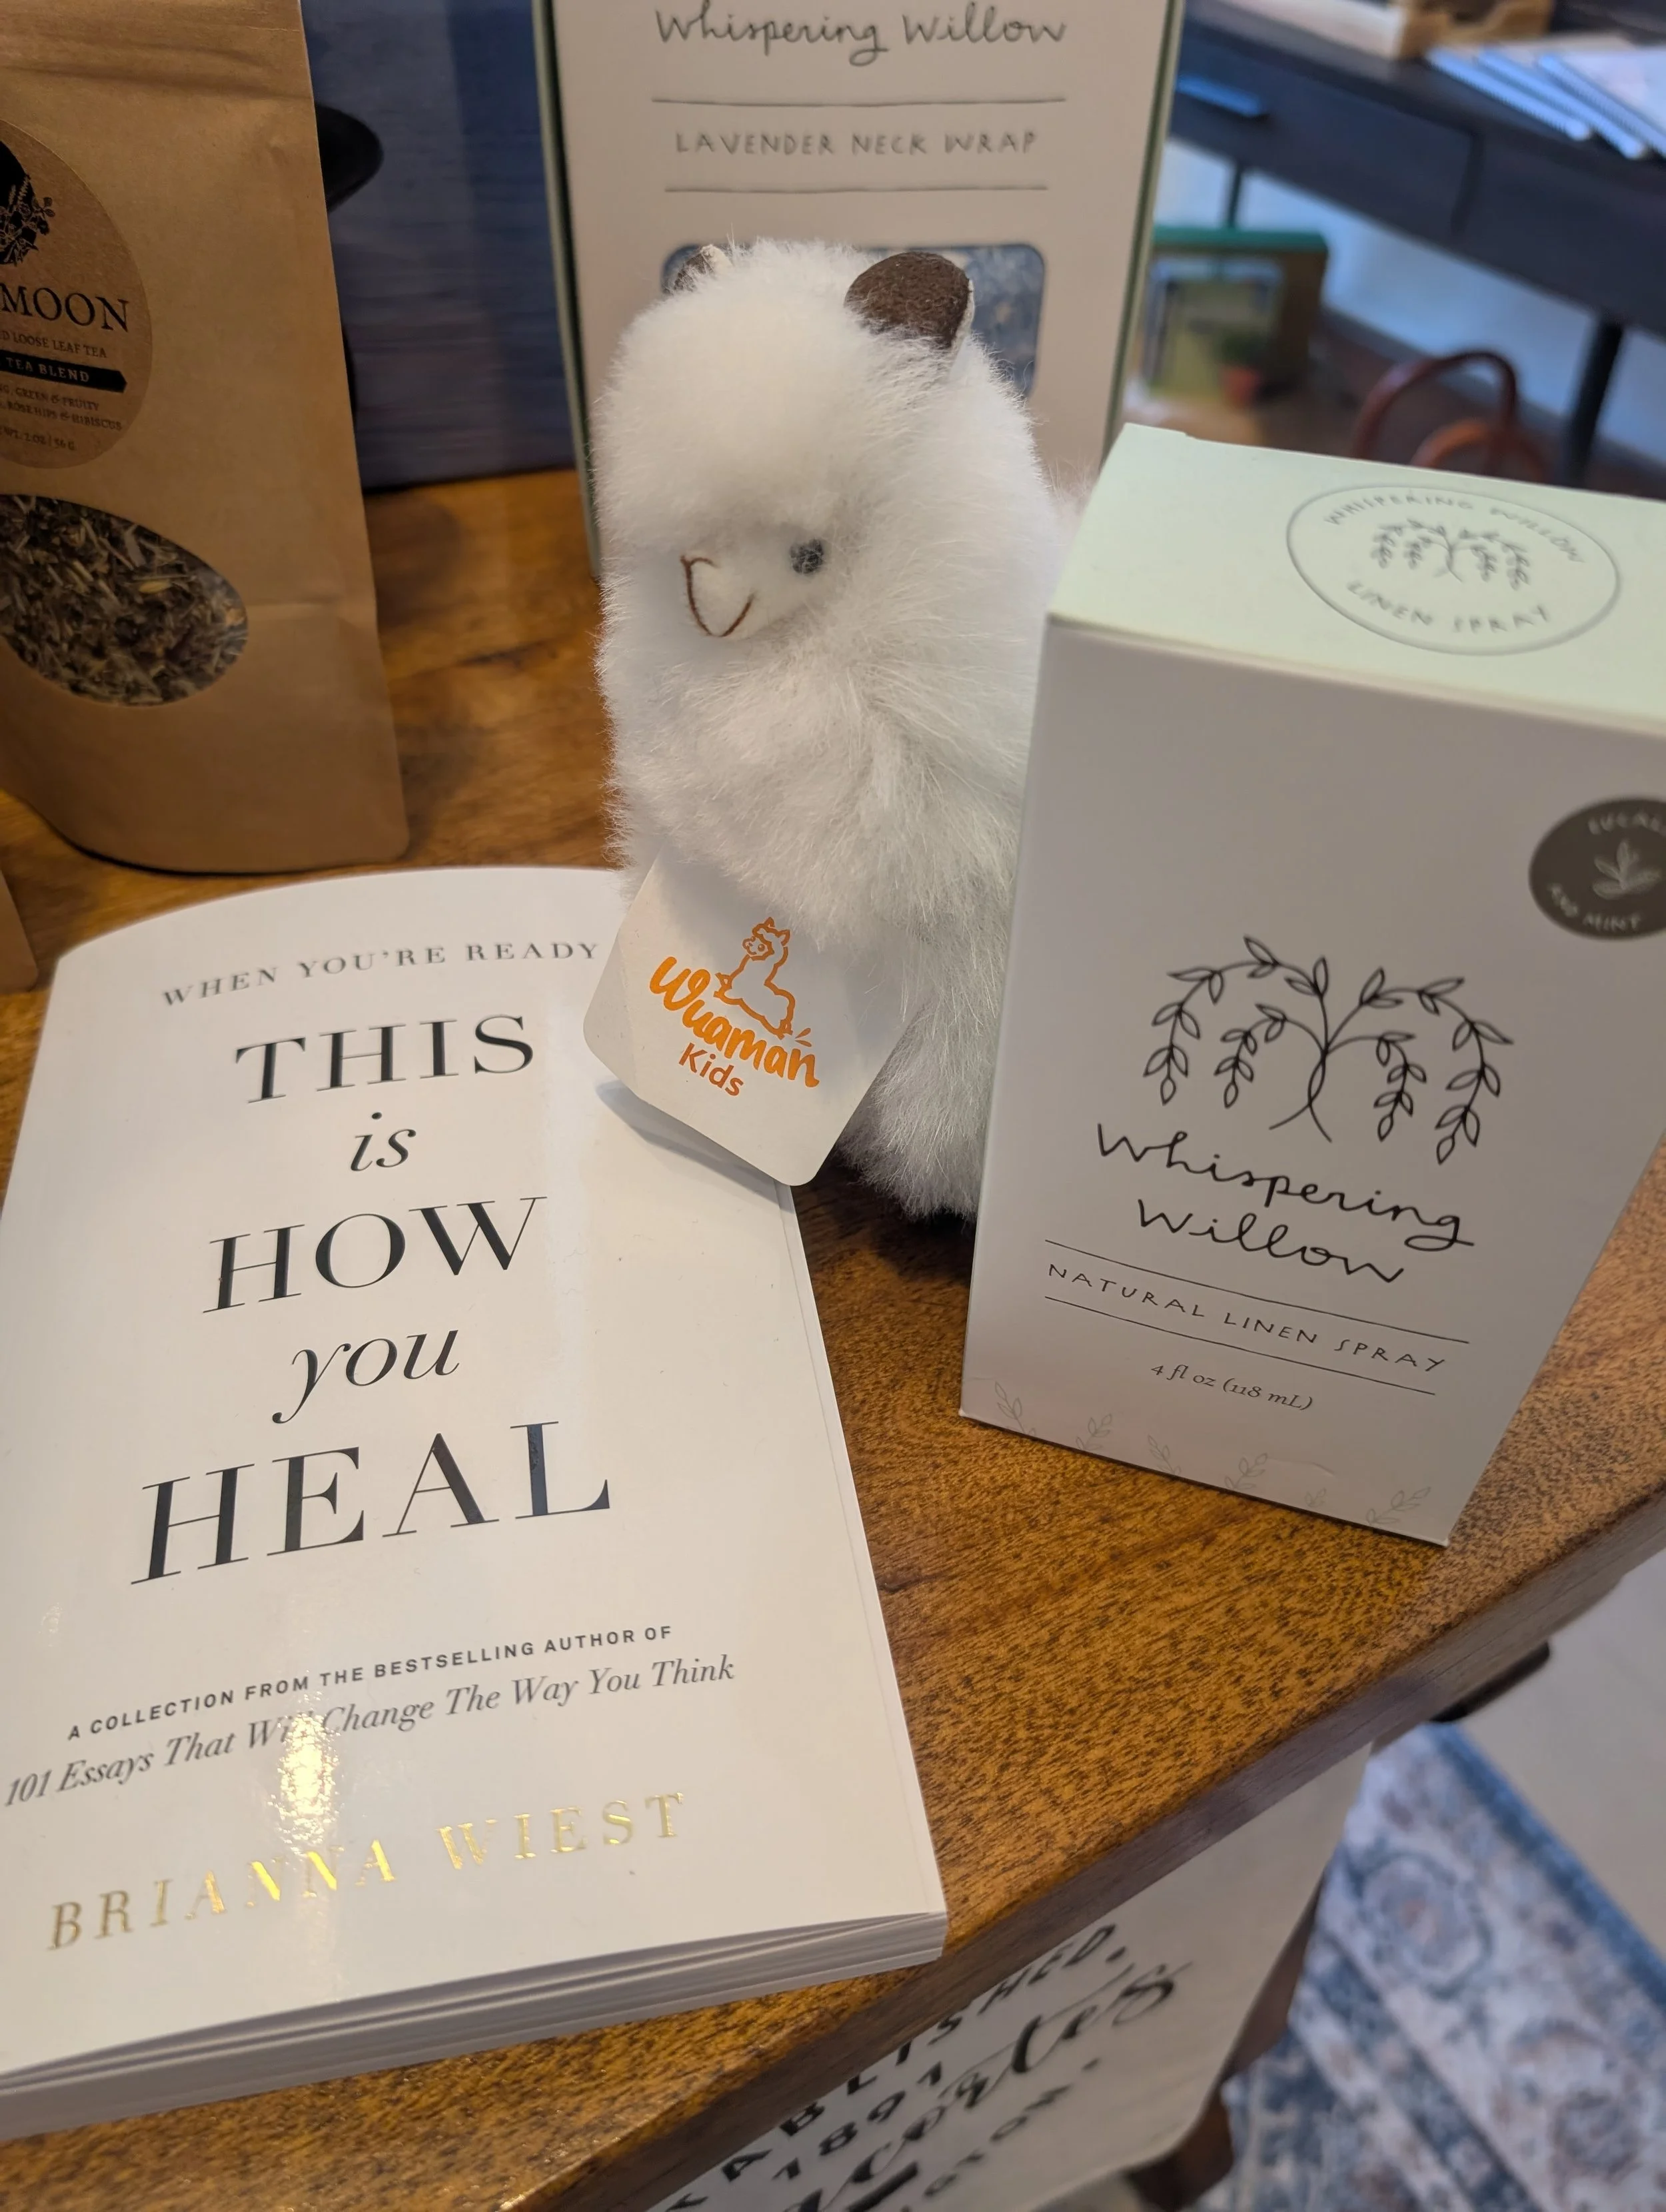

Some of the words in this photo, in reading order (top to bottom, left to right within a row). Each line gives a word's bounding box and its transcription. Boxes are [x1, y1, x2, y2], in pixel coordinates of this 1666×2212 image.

[655, 0, 889, 66] Whispering
[902, 1, 1066, 45] Willow
[675, 132, 834, 155] LAVENDER
[852, 132, 928, 156] NECK
[944, 131, 1038, 155] WRAP
[0, 282, 129, 332] MOON
[13, 333, 49, 348] LOOSE
[52, 340, 80, 354] LEAF
[83, 344, 107, 358] TEA
[6, 357, 33, 372] TEA
[39, 364, 90, 382] BLEND
[1347, 580, 1433, 626] LINEN
[1452, 604, 1548, 632] SPRAY
[161, 967, 278, 1006] WHEN
[298, 947, 446, 978] YOU'RE
[466, 941, 599, 961] READY
[236, 1013, 534, 1104] THIS
[650, 956, 820, 1087] Wuaman
[678, 1042, 744, 1096] Kids
[350, 1111, 416, 1172] is
[1097, 1123, 1475, 1251] Whispering
[202, 1197, 548, 1313] HOW
[1138, 1199, 1404, 1283] Willow
[1048, 1263, 1205, 1318] NATURAL
[1224, 1313, 1317, 1344] LINEN
[1335, 1339, 1445, 1373] SPRAY
[271, 1329, 460, 1424] you
[1151, 1365, 1164, 1376] 4
[1166, 1364, 1189, 1381] fl
[1193, 1375, 1216, 1386] oz
[1223, 1378, 1262, 1398] (118
[1267, 1392, 1313, 1410] mL)
[131, 1421, 610, 1584] HEAL
[67, 1726, 81, 1741] A
[91, 1690, 234, 1734] COLLECTION
[245, 1676, 309, 1700] FROM
[320, 1667, 364, 1686] THE
[374, 1642, 534, 1678] BESTSELLING
[544, 1630, 635, 1653] AUTHOR
[644, 1626, 672, 1641] OF
[4, 1770, 52, 1807] 101
[56, 1752, 155, 1792] Essays
[165, 1732, 237, 1767] That
[323, 1700, 435, 1733] Change
[446, 1684, 500, 1716] The
[511, 1675, 578, 1707] Way
[588, 1667, 641, 1695] You
[651, 1654, 735, 1687] Think
[47, 1839, 396, 1951] BRIANNA
[436, 1792, 684, 1870] WIEST
[771, 2060, 942, 2181] 1891
